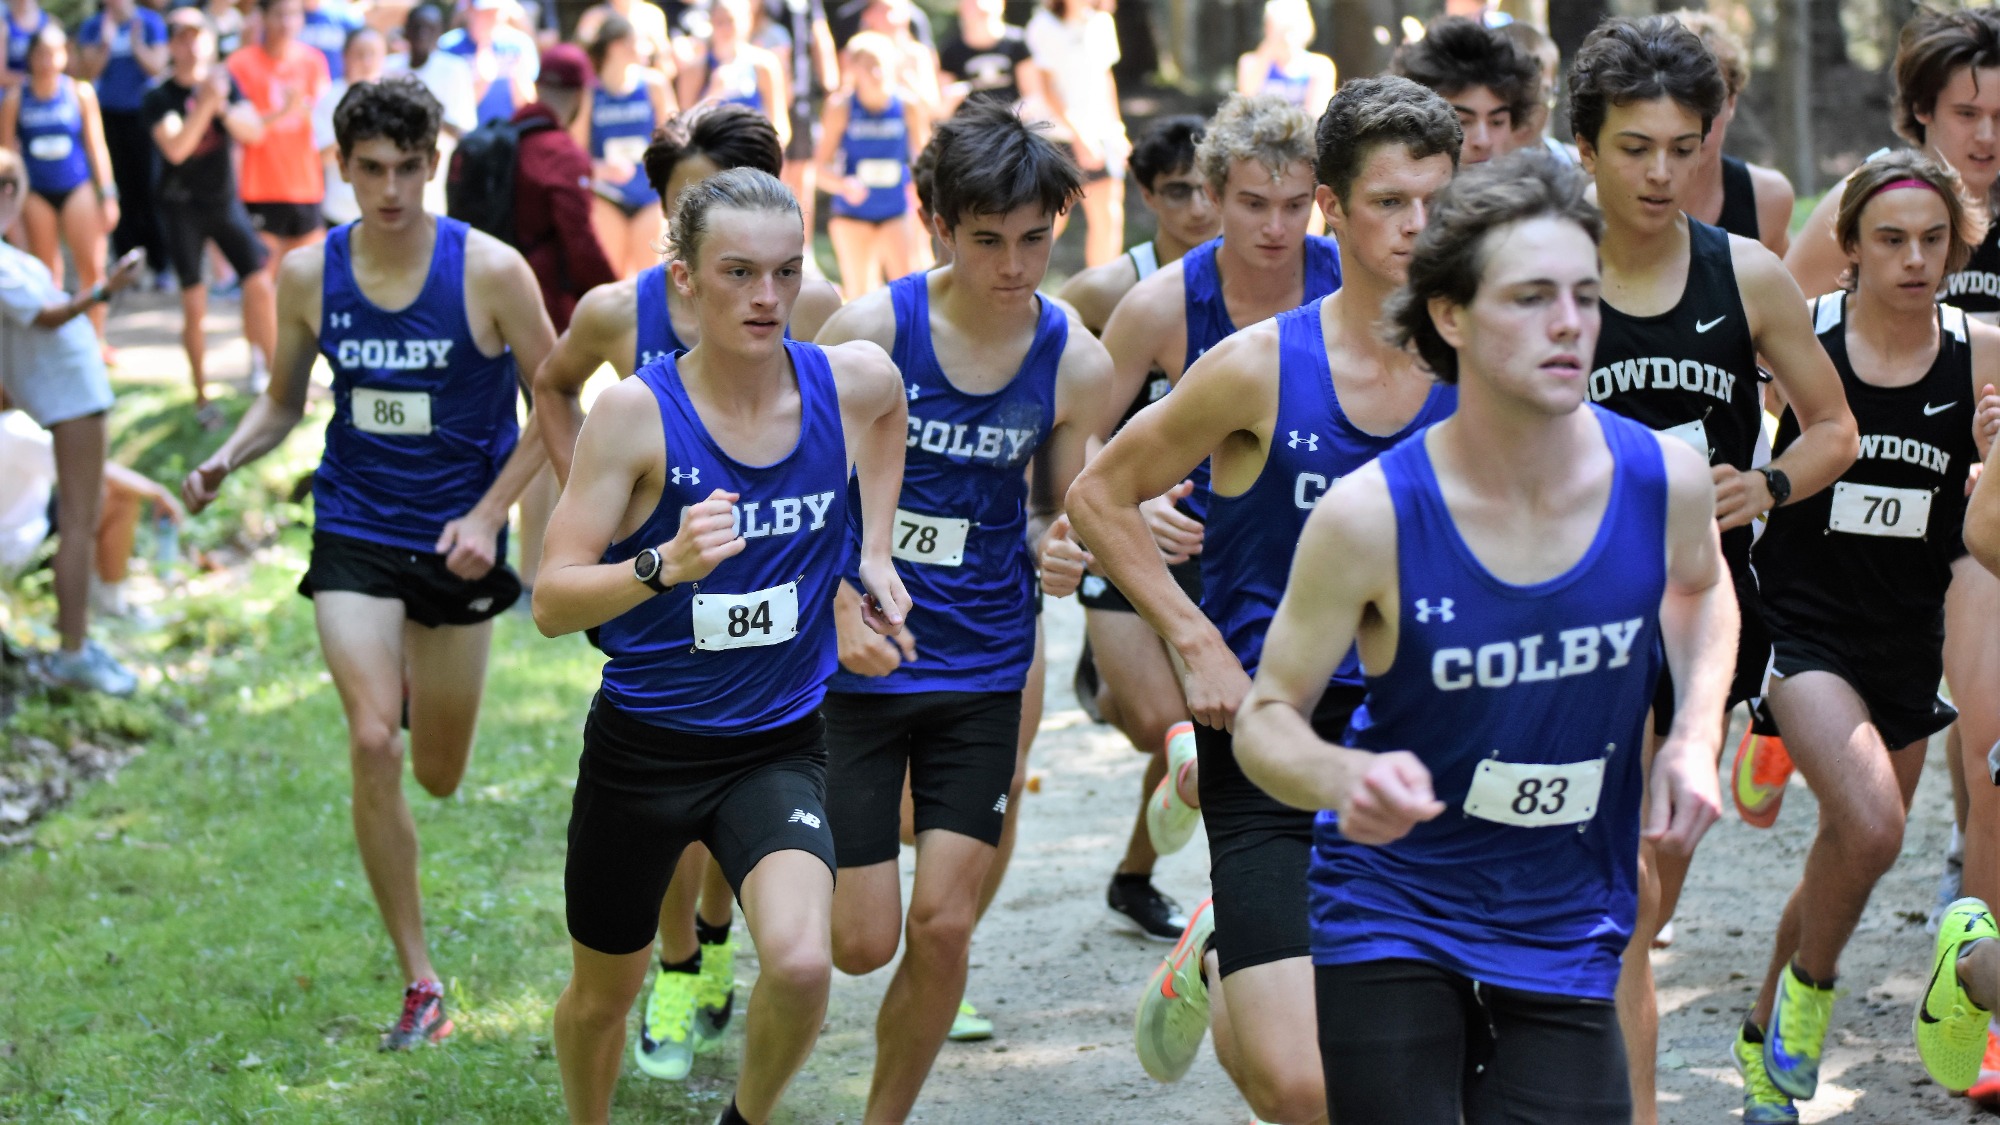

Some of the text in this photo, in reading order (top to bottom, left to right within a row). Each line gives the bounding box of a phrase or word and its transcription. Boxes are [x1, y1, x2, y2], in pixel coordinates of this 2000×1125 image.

[338, 339, 453, 369] COLBY
[1584, 357, 1736, 403] OWDOIN
[373, 398, 405, 426] 86
[680, 491, 835, 538] LBY
[1862, 495, 1902, 527] 70
[898, 520, 939, 554] 78
[727, 599, 773, 638] 84
[1431, 617, 1644, 691] COLBY
[1511, 777, 1569, 815] 83
